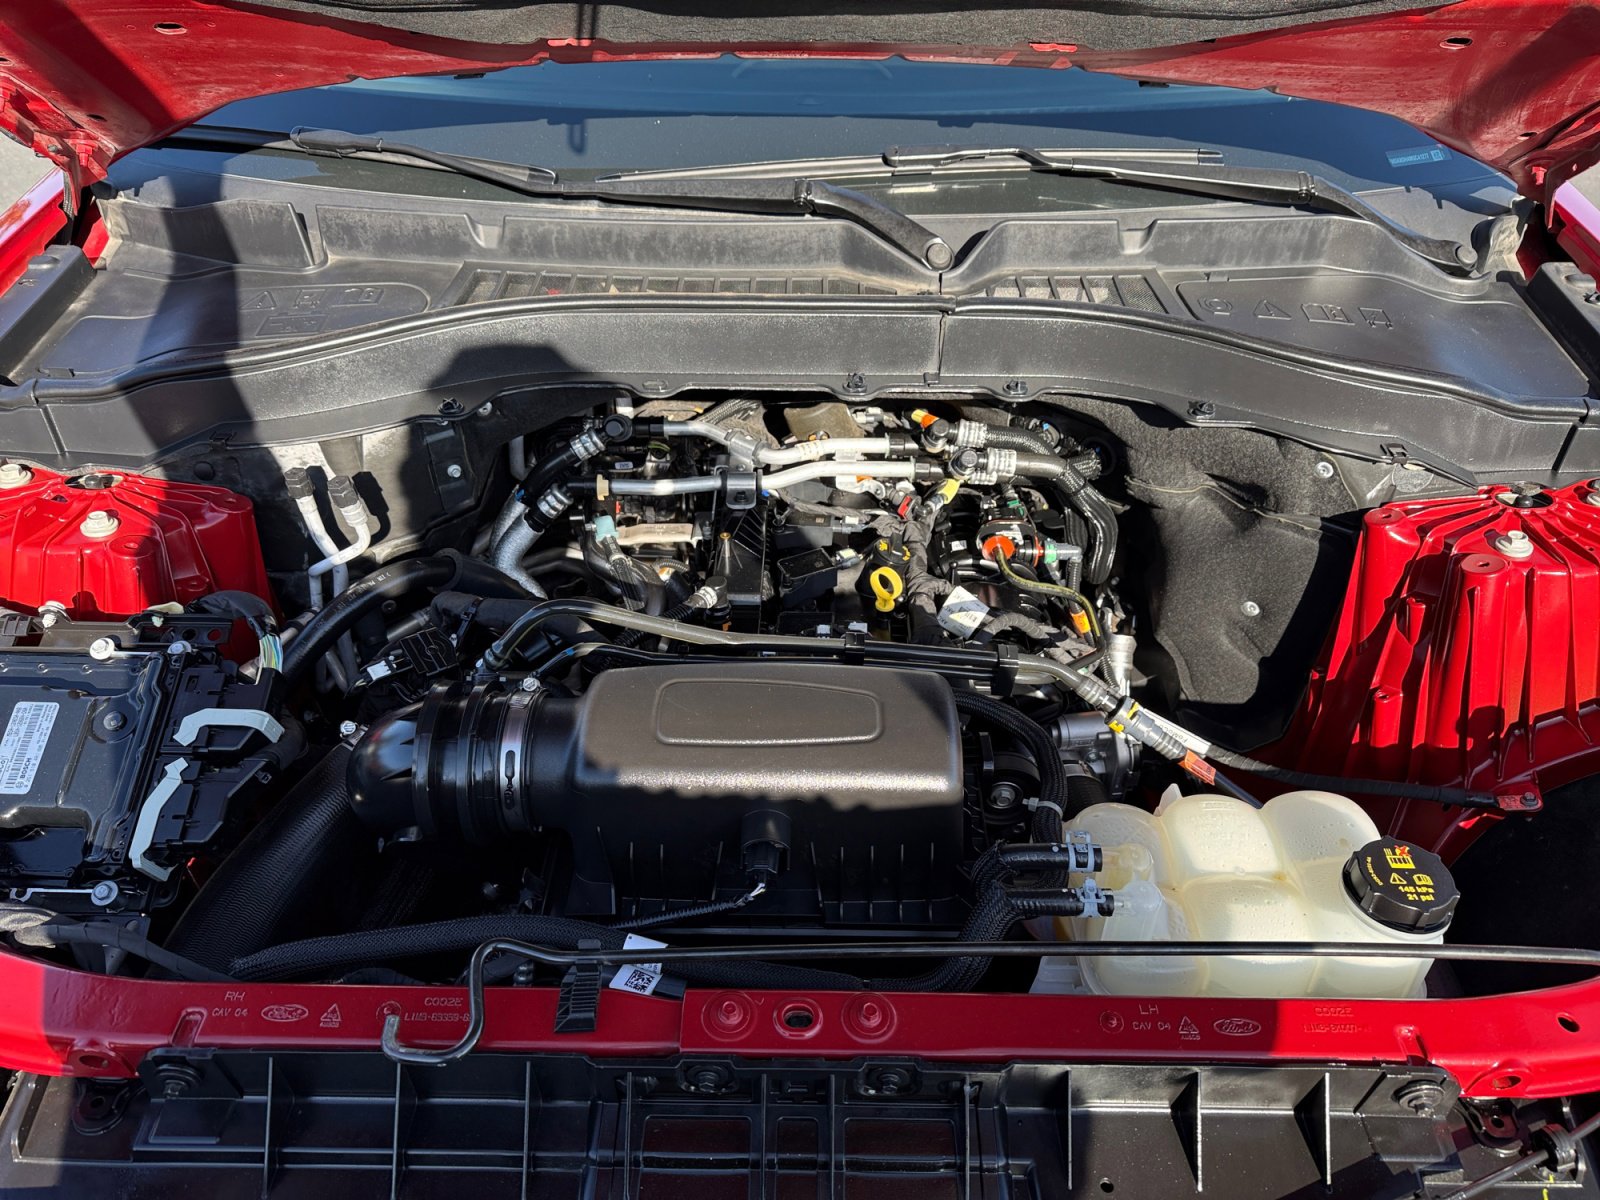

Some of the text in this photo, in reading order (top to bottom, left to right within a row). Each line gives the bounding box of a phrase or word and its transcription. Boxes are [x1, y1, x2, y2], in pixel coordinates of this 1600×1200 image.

[20, 757, 32, 779] BOSCH
[1420, 894, 1435, 902] psi
[225, 991, 245, 1001] RH
[212, 1008, 248, 1017] CAV 04
[1139, 1003, 1159, 1015] LH
[1132, 1021, 1151, 1031] CAV
[1218, 1018, 1257, 1035] Ford
